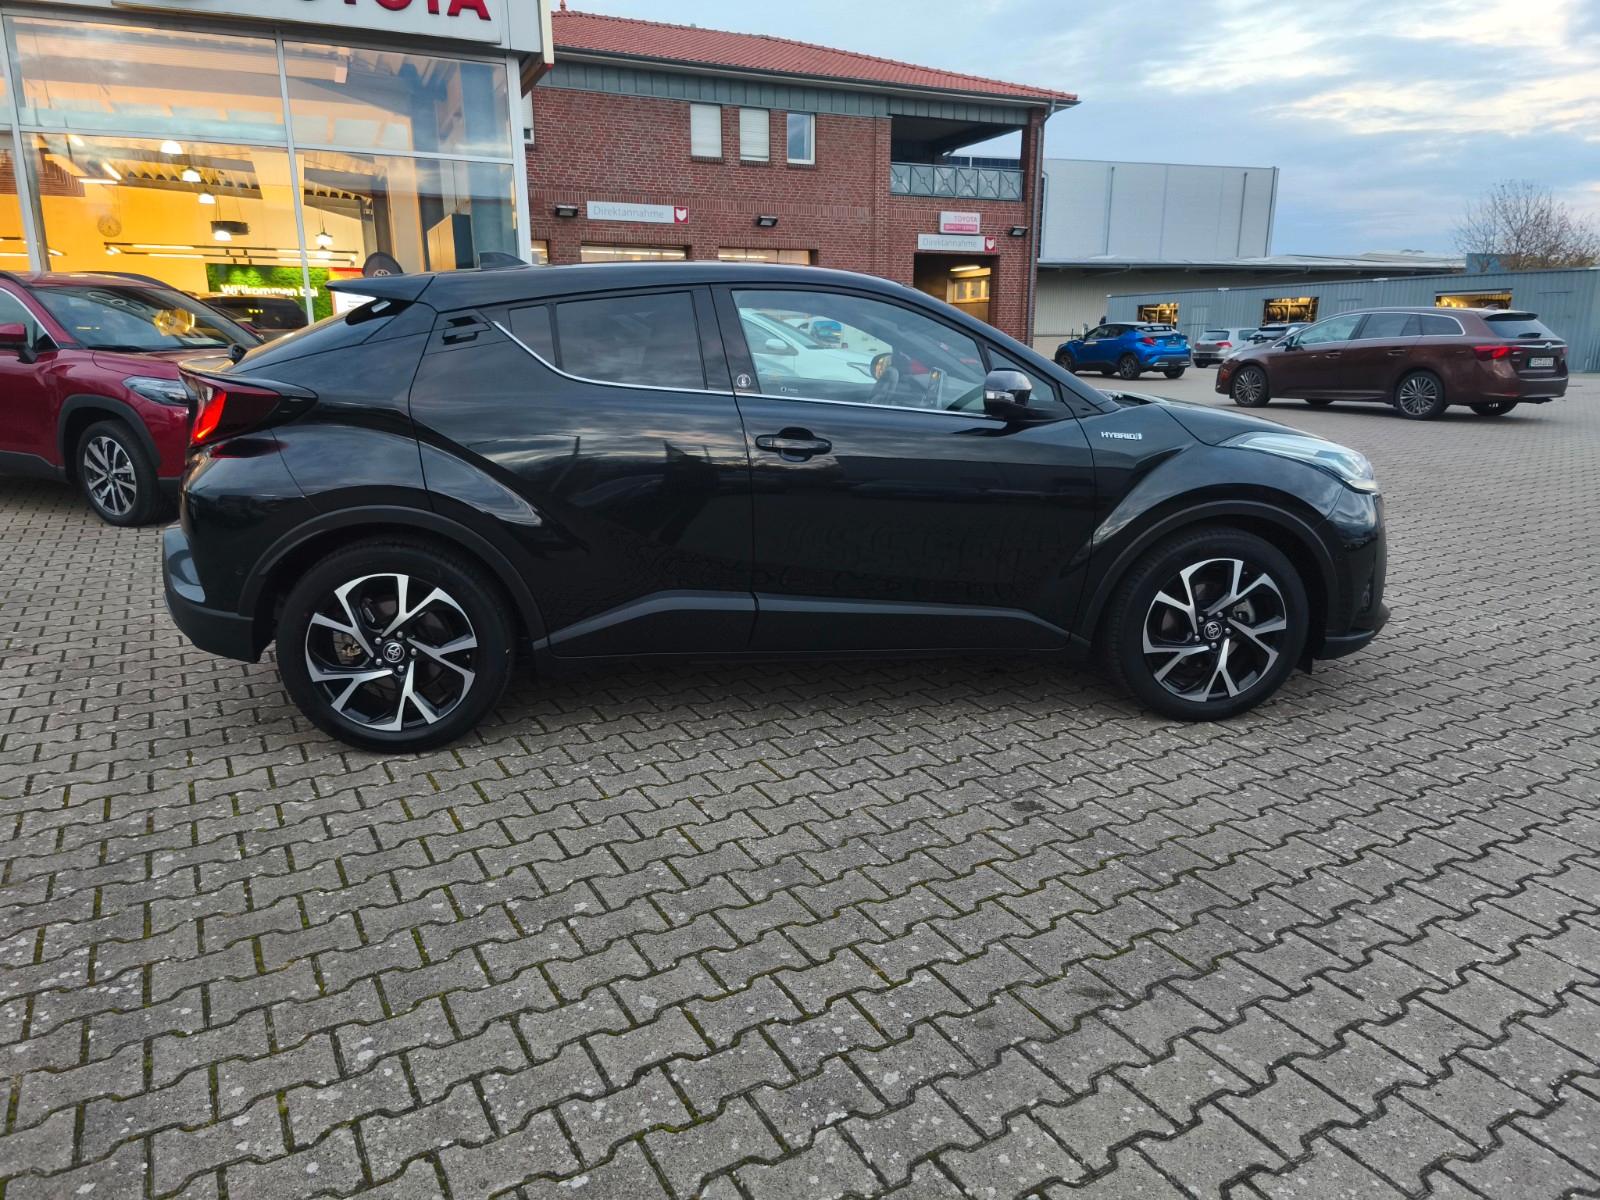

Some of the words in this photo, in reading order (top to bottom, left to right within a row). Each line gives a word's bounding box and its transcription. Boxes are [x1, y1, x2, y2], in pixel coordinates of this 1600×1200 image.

[953, 215, 977, 223] TOYOTA
[220, 284, 298, 297] Willkommen
[1100, 431, 1137, 441] HYBRID
